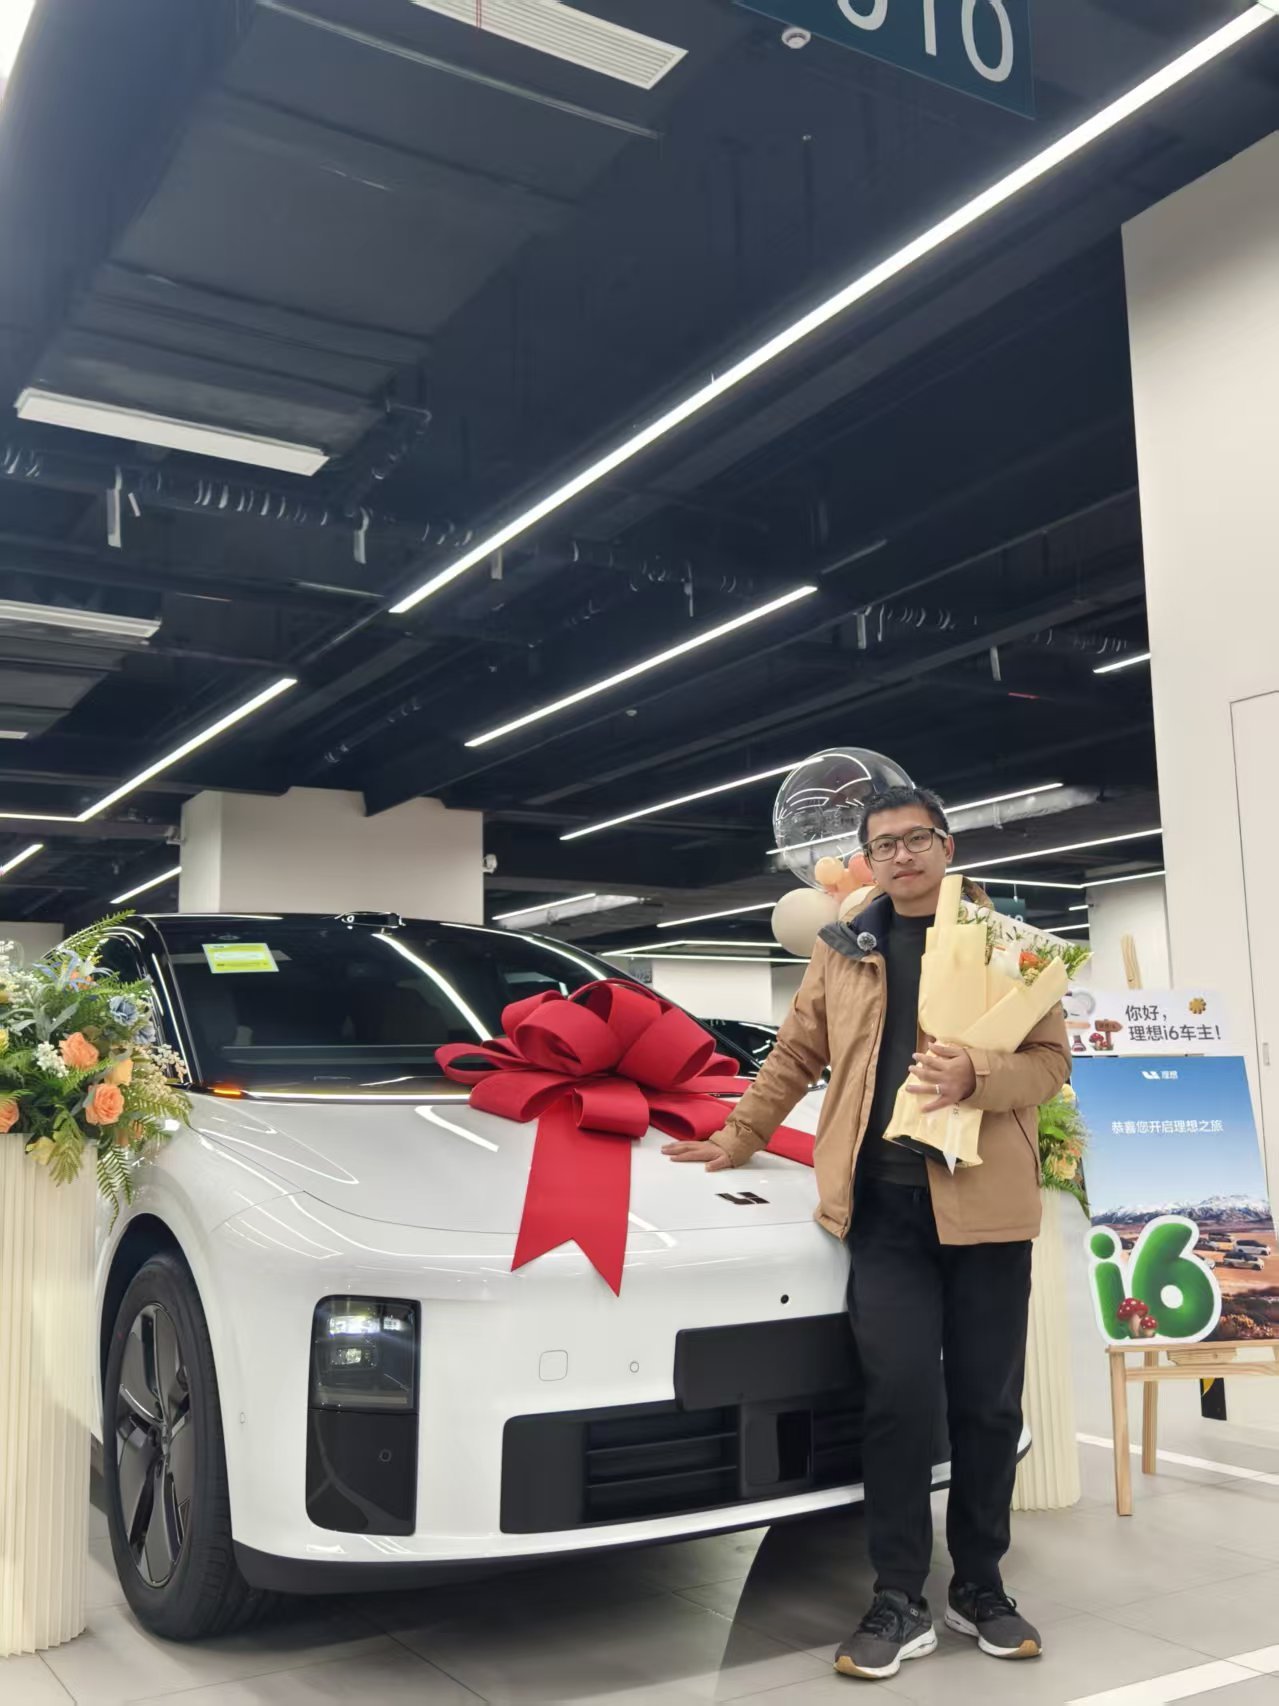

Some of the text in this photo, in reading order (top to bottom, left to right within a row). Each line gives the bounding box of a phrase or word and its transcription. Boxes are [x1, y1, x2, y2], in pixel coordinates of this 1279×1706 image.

[1111, 1120, 1224, 1134] 恭喜您开启理想之旅
[1090, 1222, 1215, 1342] i6
